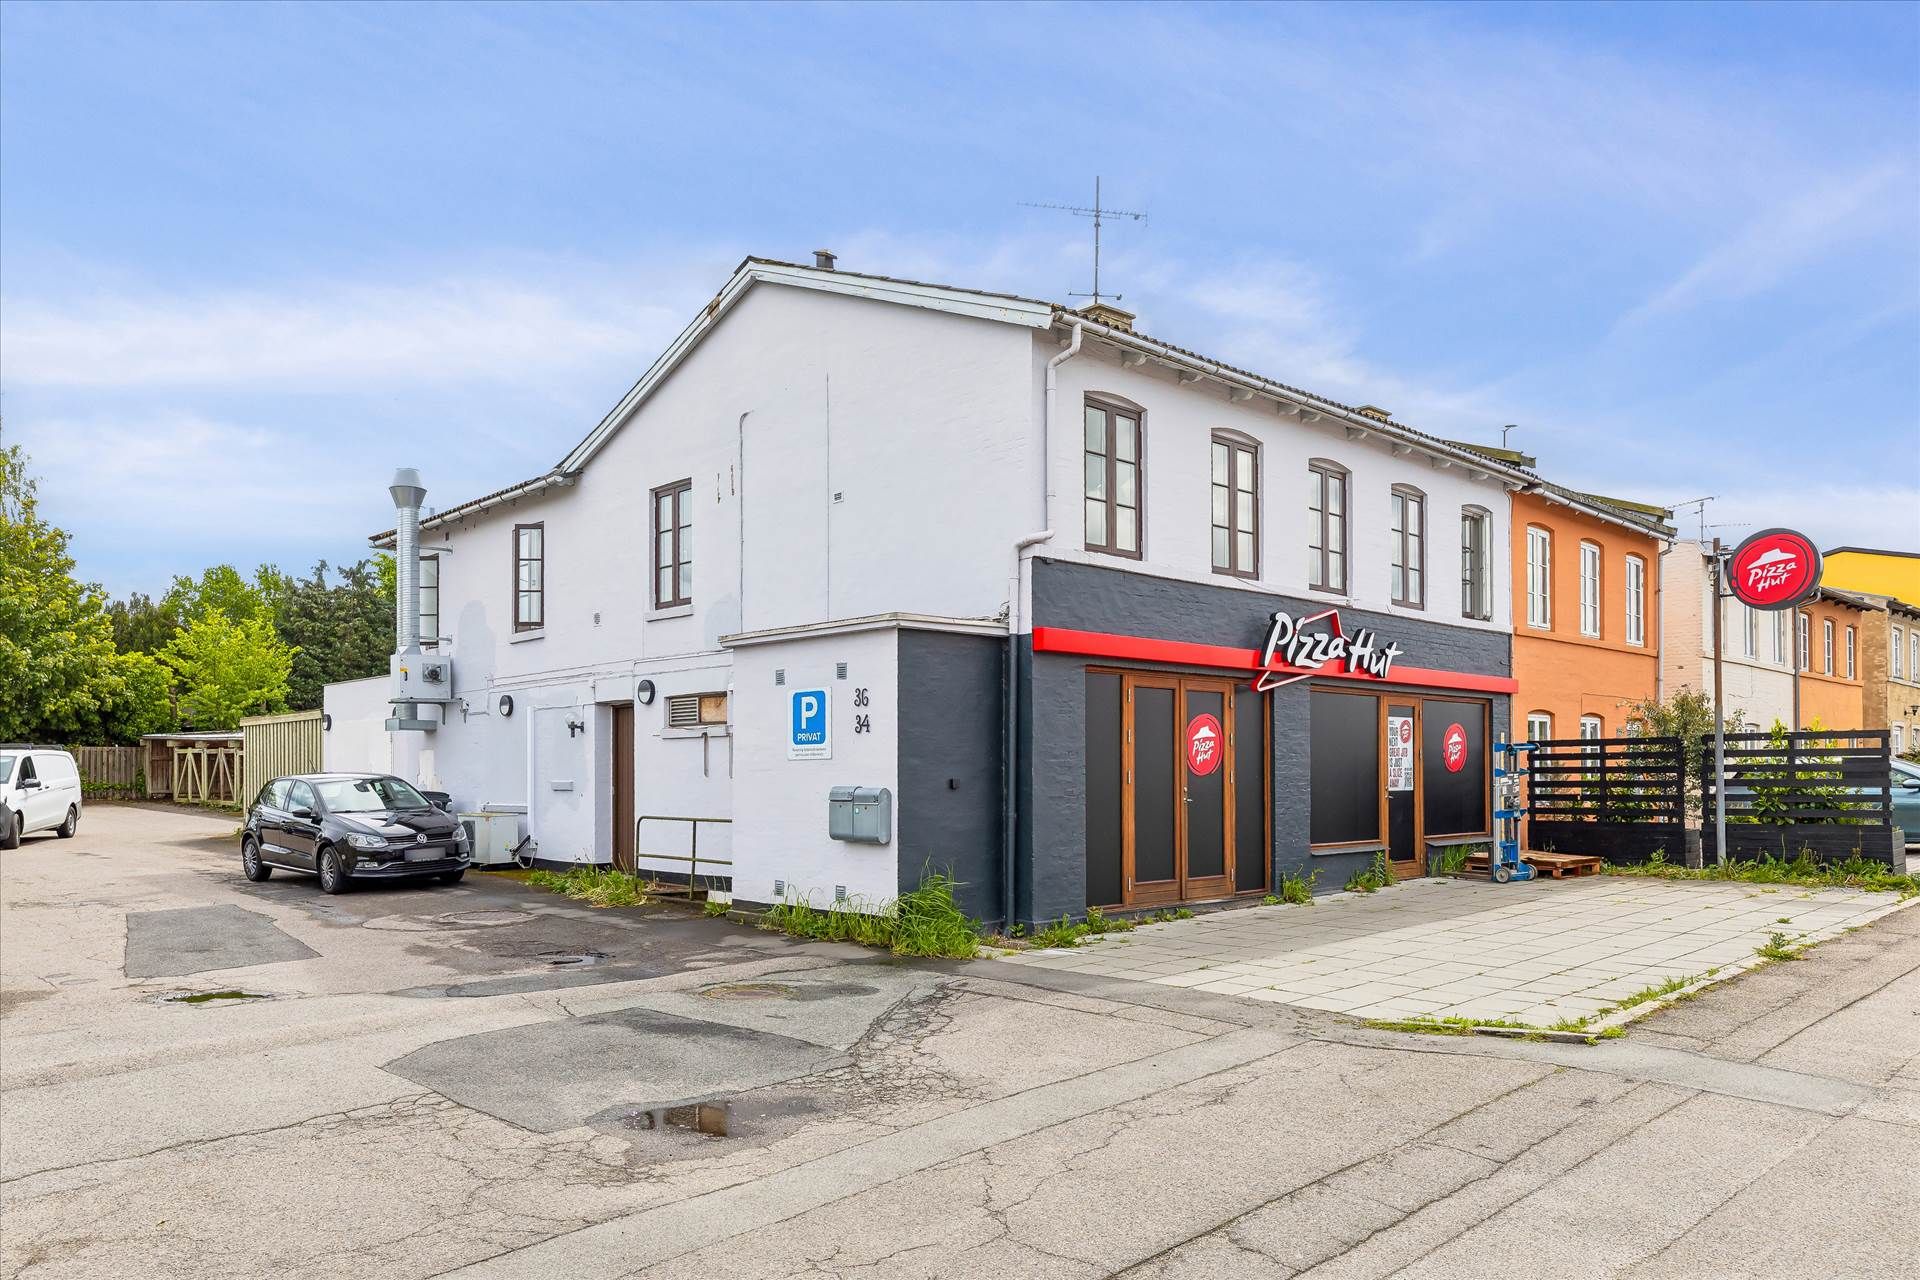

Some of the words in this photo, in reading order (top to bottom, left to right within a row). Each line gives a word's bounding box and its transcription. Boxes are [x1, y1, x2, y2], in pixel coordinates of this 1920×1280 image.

[1747, 561, 1797, 587] Pizza
[1757, 573, 1792, 592] Hut
[1263, 611, 1346, 669] Pizza
[1348, 628, 1404, 678] Hut
[853, 687, 869, 707] 36
[801, 695, 818, 730] P
[854, 713, 871, 734] 34
[797, 732, 821, 742] PRIVAT
[1192, 739, 1215, 757] Pizza
[1196, 749, 1214, 765] Hut
